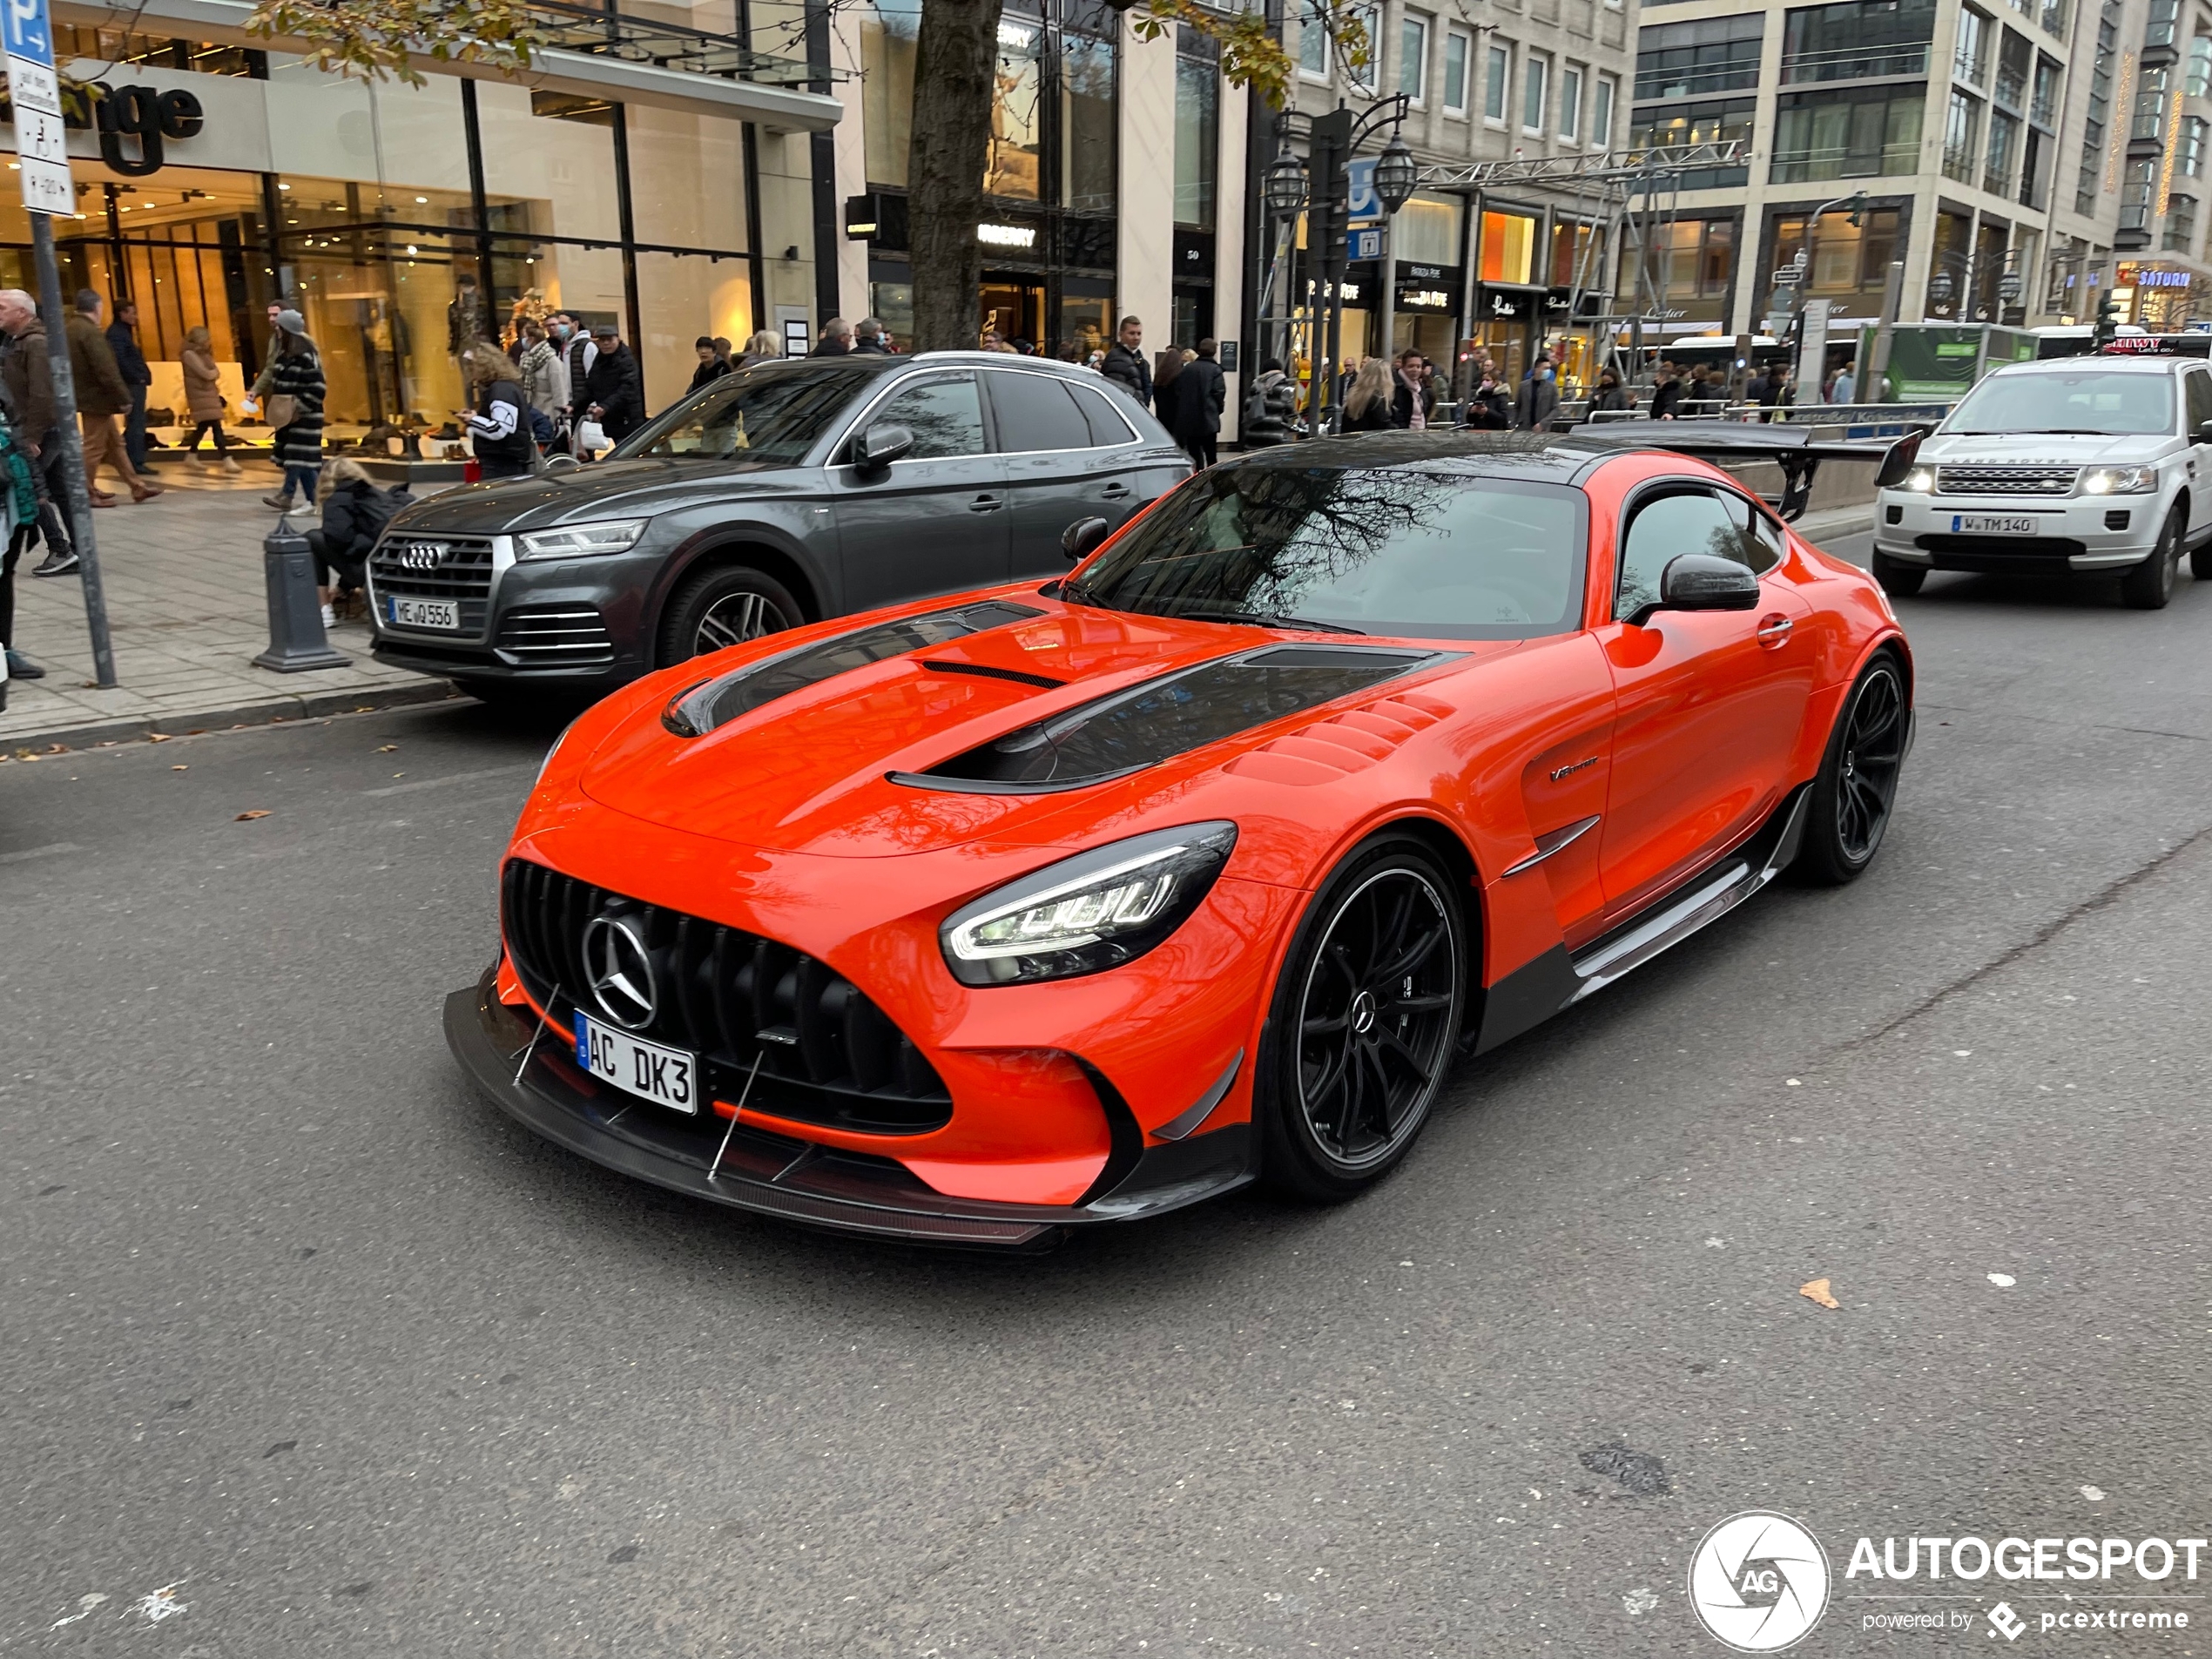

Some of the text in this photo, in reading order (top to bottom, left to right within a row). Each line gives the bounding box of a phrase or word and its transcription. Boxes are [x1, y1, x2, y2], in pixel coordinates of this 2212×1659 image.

[1350, 169, 1373, 212] U
[1187, 250, 1199, 260] 50
[2138, 271, 2191, 287] SATURN
[398, 602, 412, 622] ME
[590, 1027, 616, 1076] AC
